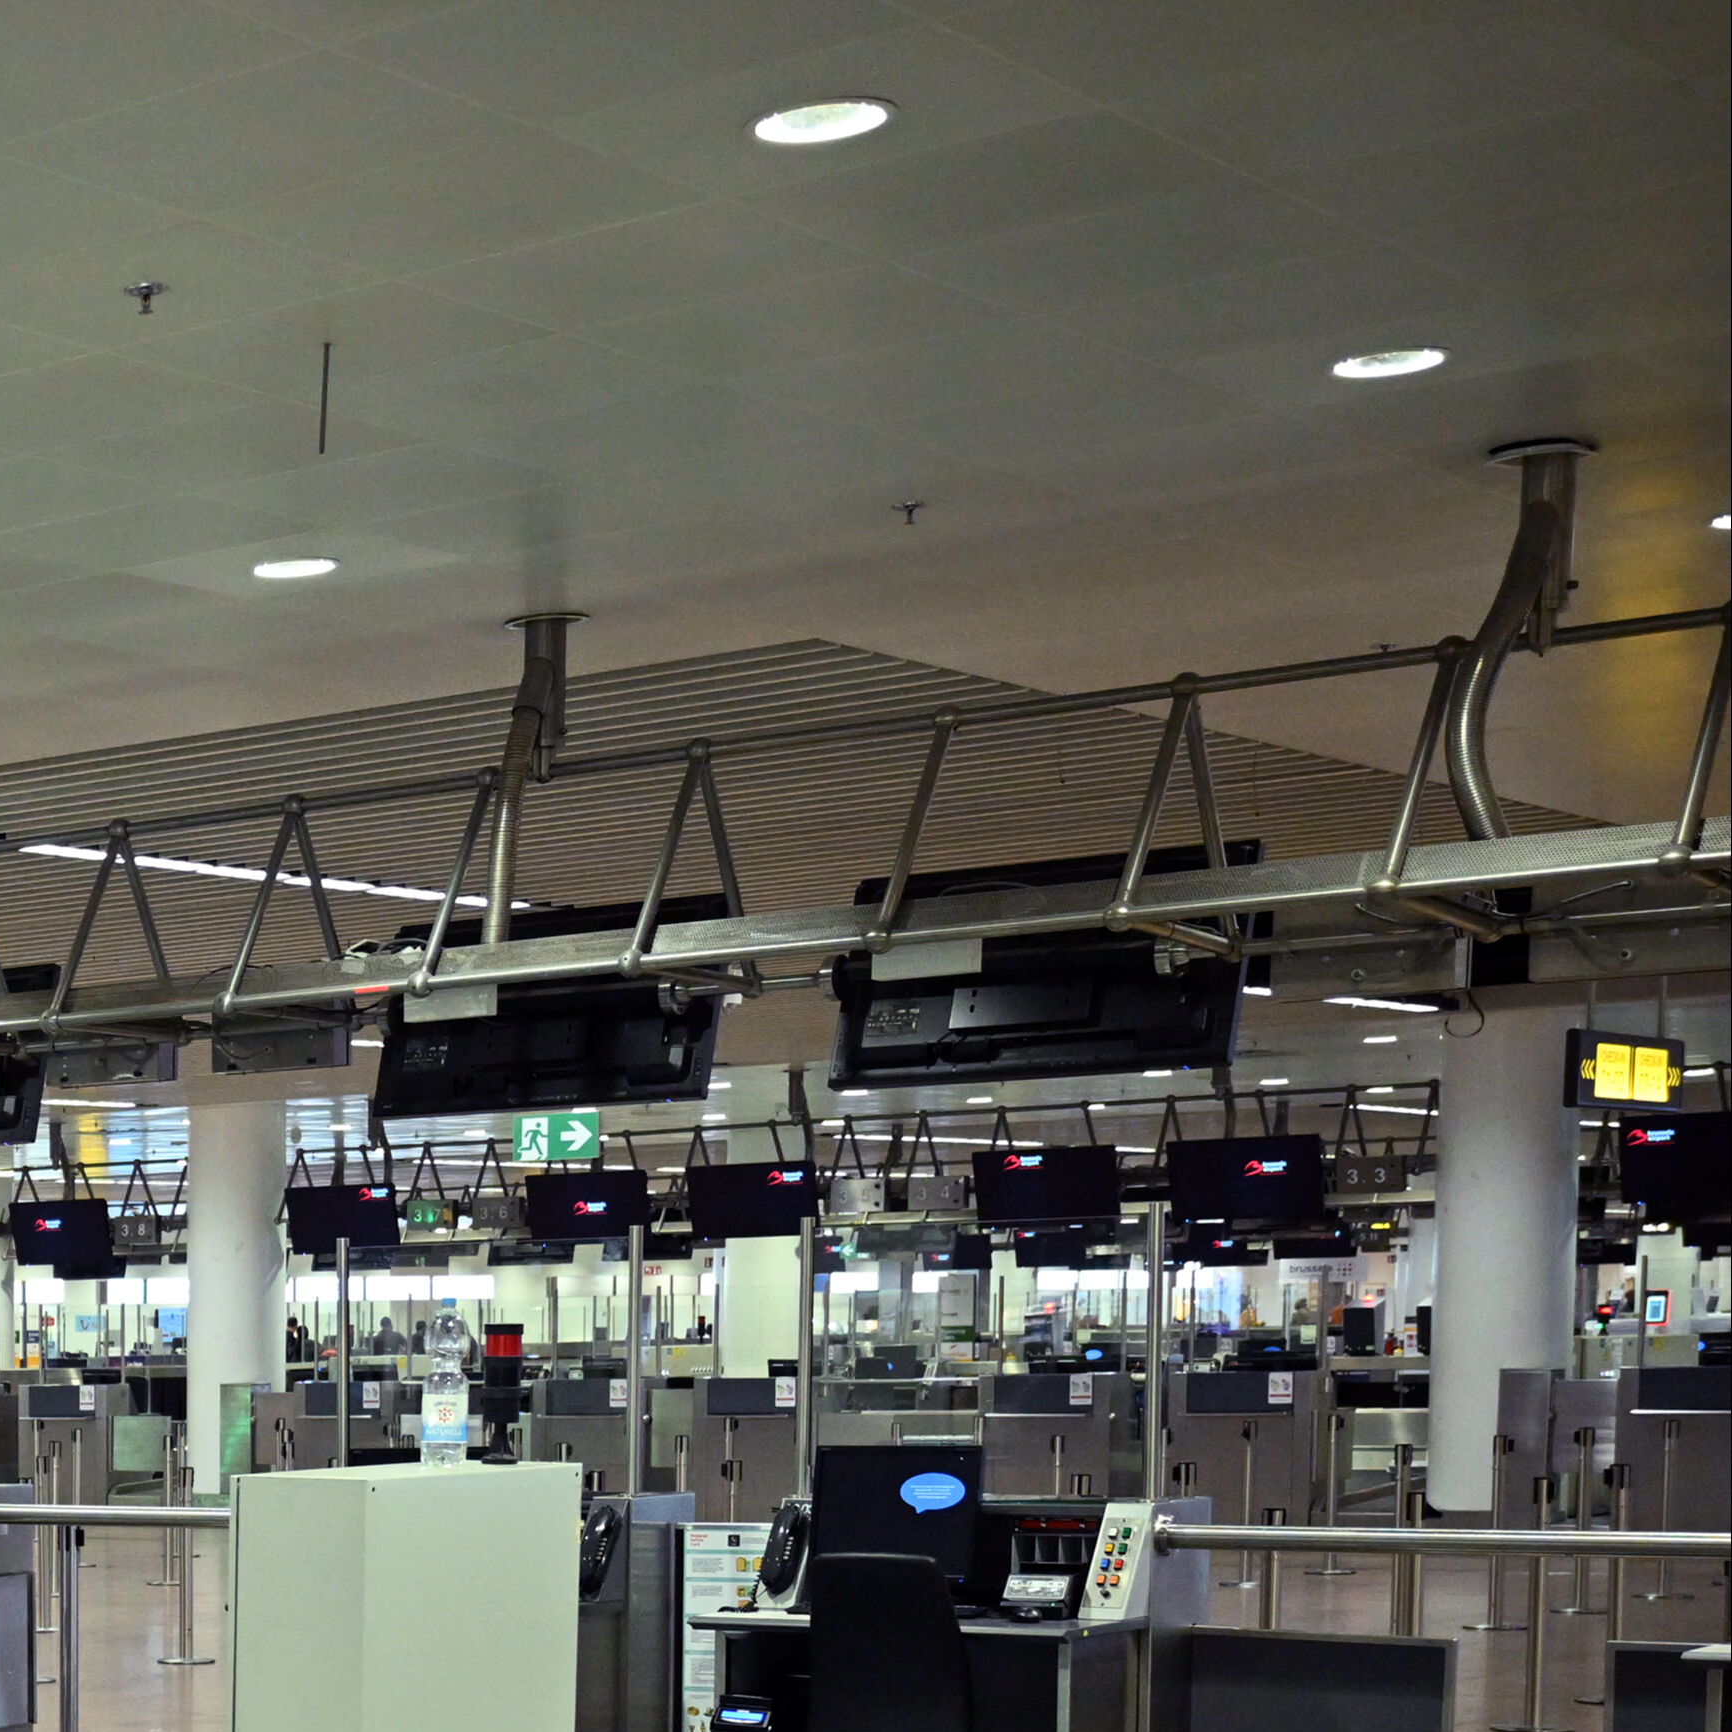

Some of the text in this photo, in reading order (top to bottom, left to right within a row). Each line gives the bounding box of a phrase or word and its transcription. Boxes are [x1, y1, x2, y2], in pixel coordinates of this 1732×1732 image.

[1347, 1167, 1387, 1184] 3.3
[479, 1206, 508, 1220] 3.6
[121, 1223, 147, 1238] 3.8
